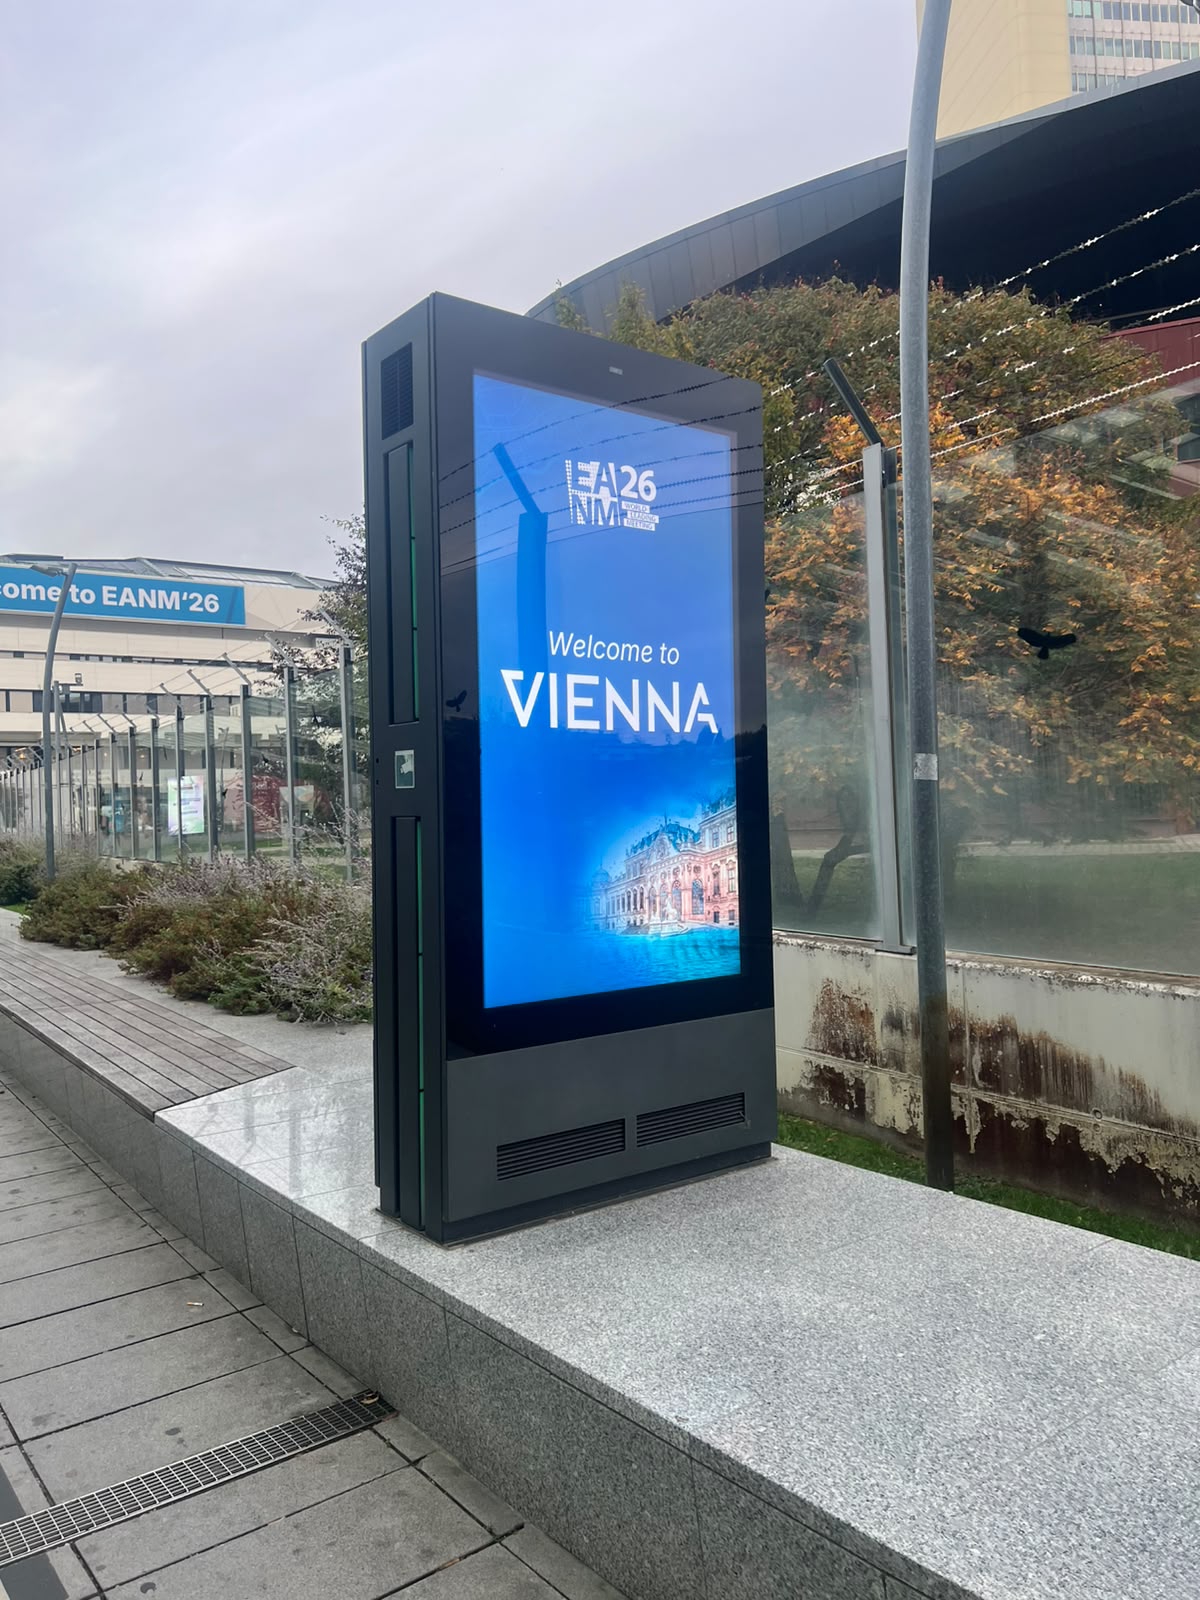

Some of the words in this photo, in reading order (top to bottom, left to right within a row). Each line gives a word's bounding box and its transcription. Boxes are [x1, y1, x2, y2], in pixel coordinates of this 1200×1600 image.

[620, 465, 657, 502] 26
[624, 502, 648, 513] WORLD
[629, 510, 657, 522] LEADING
[626, 518, 653, 530] MEETING
[0, 582, 60, 602] ome
[69, 584, 96, 605] to
[549, 630, 653, 663] Welcome
[660, 643, 680, 665] to
[500, 669, 719, 734] VIENNA
